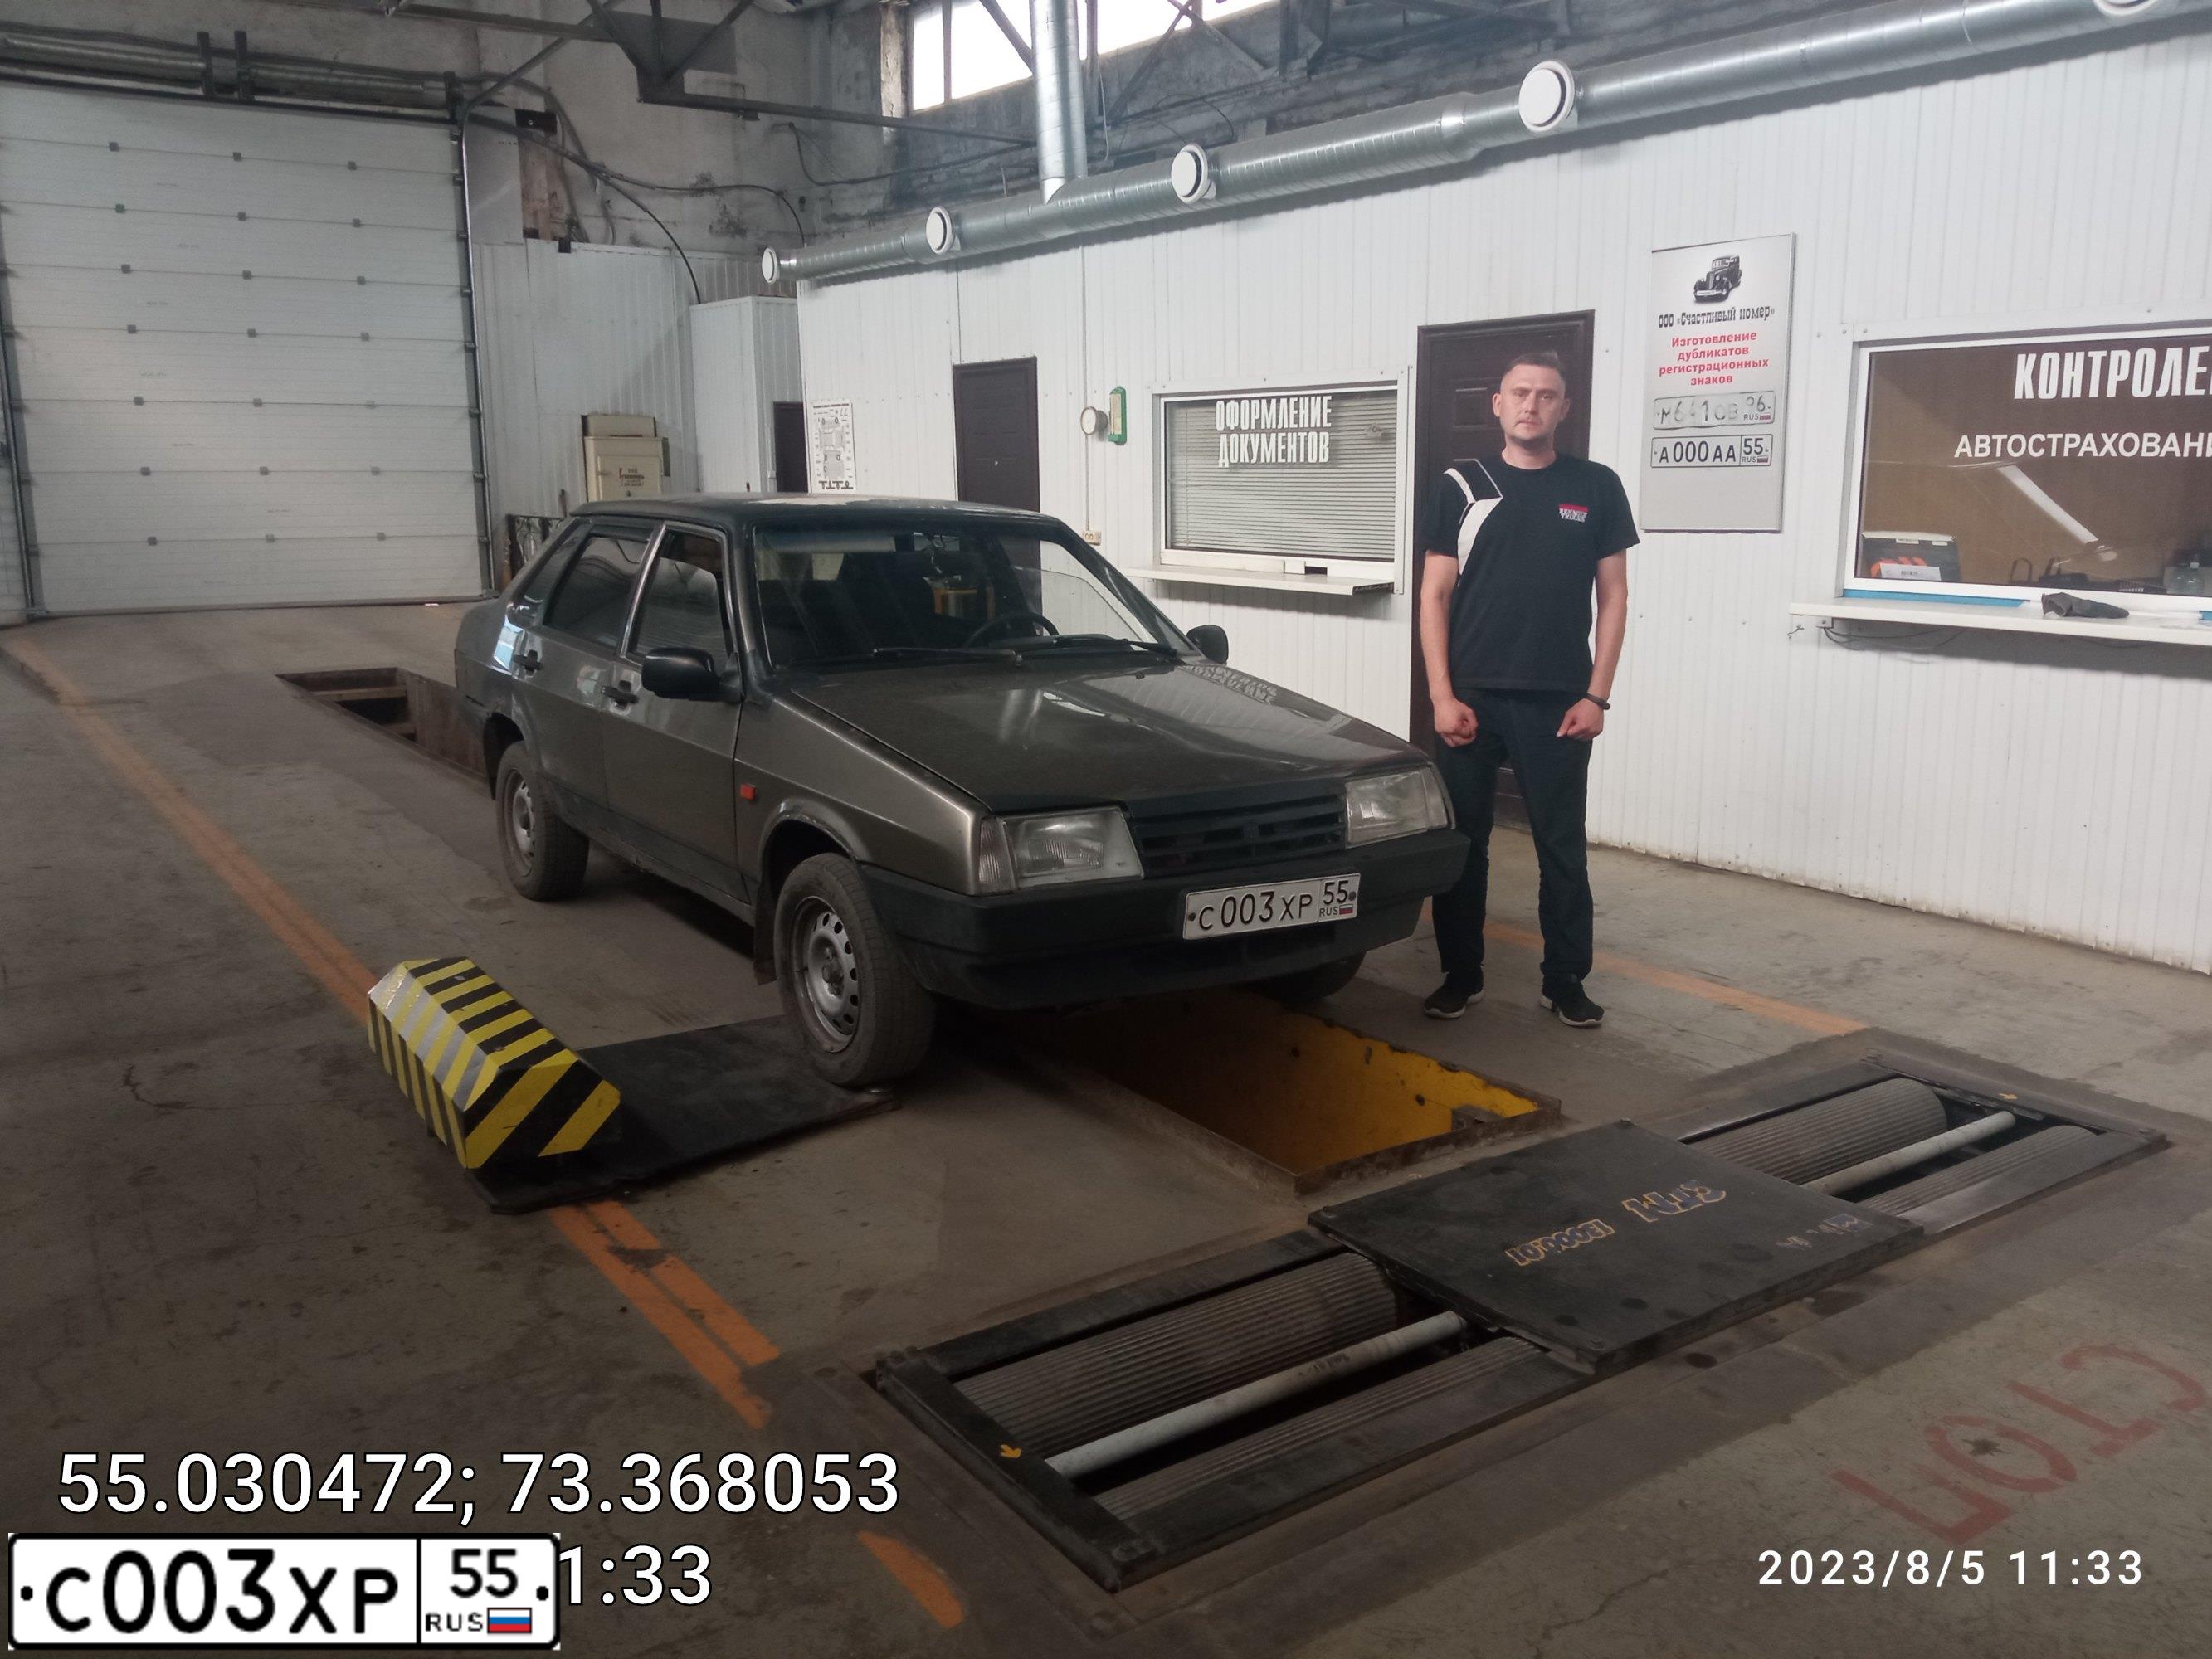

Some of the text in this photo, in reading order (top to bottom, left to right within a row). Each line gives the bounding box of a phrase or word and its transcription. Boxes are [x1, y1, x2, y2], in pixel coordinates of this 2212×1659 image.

[1658, 305, 1776, 328] ООО «Счастливый номер»
[1671, 332, 1757, 348] Изготовление
[1677, 346, 1750, 362] дубликатов
[1659, 358, 1770, 377] регистрационных
[2014, 346, 2212, 400] КОНТРОЛЕ
[1690, 374, 1733, 387] знаков
[1216, 396, 1333, 431] ОФОРМЛЕНИЕ
[1743, 413, 1760, 421] RUS
[1218, 431, 1330, 468] ДОКУМЕНТОВ
[1743, 437, 1764, 455] 55
[1742, 455, 1757, 464] RUS
[1323, 880, 1349, 905] 55
[1319, 906, 1338, 917] RUS
